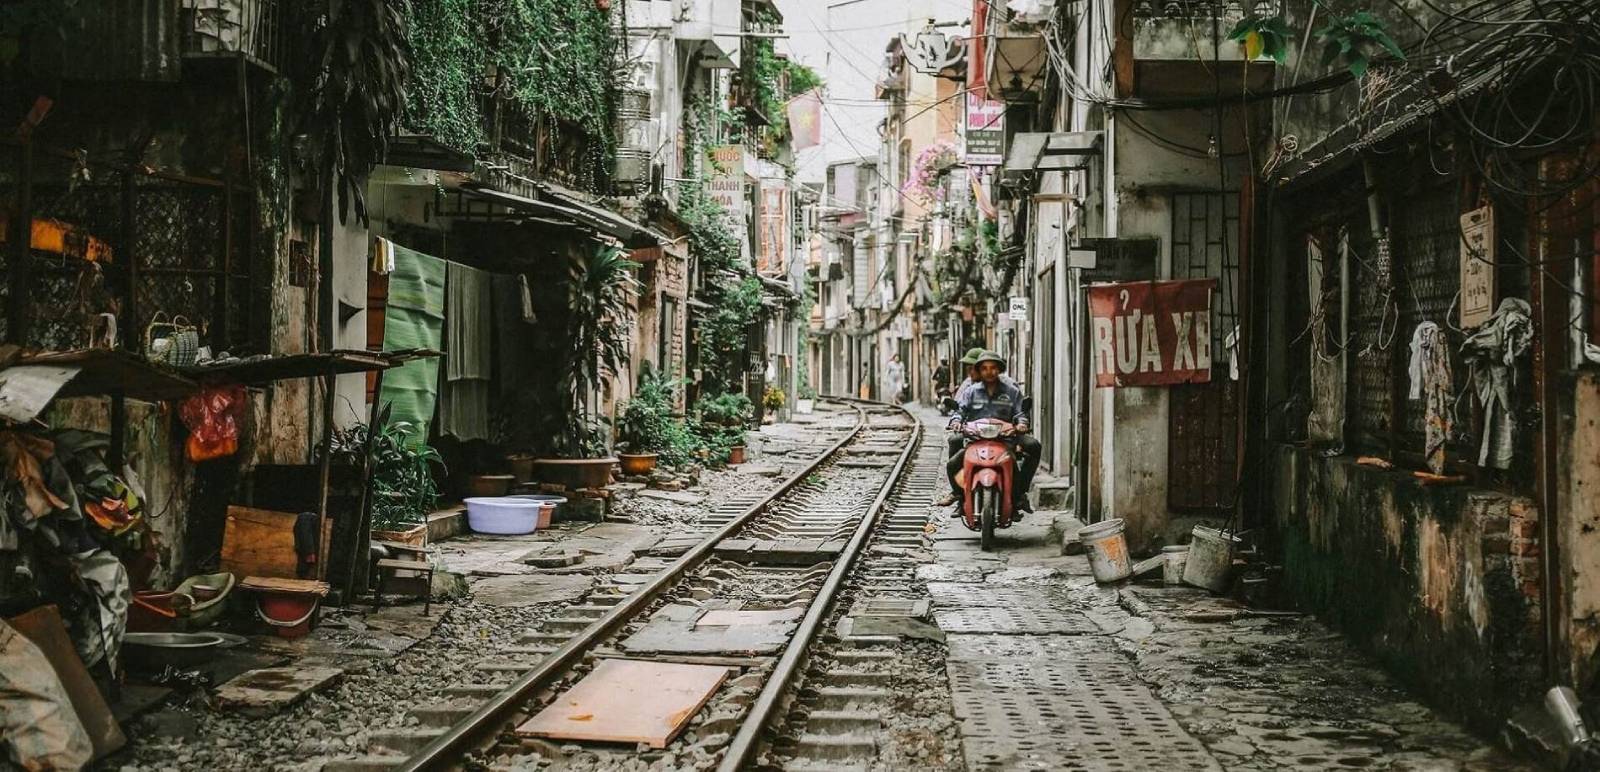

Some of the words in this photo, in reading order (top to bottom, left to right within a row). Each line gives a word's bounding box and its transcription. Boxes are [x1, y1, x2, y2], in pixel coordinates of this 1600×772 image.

[707, 181, 740, 191] THANH
[1092, 289, 1162, 374] RỬA
[1171, 311, 1211, 371] XE
